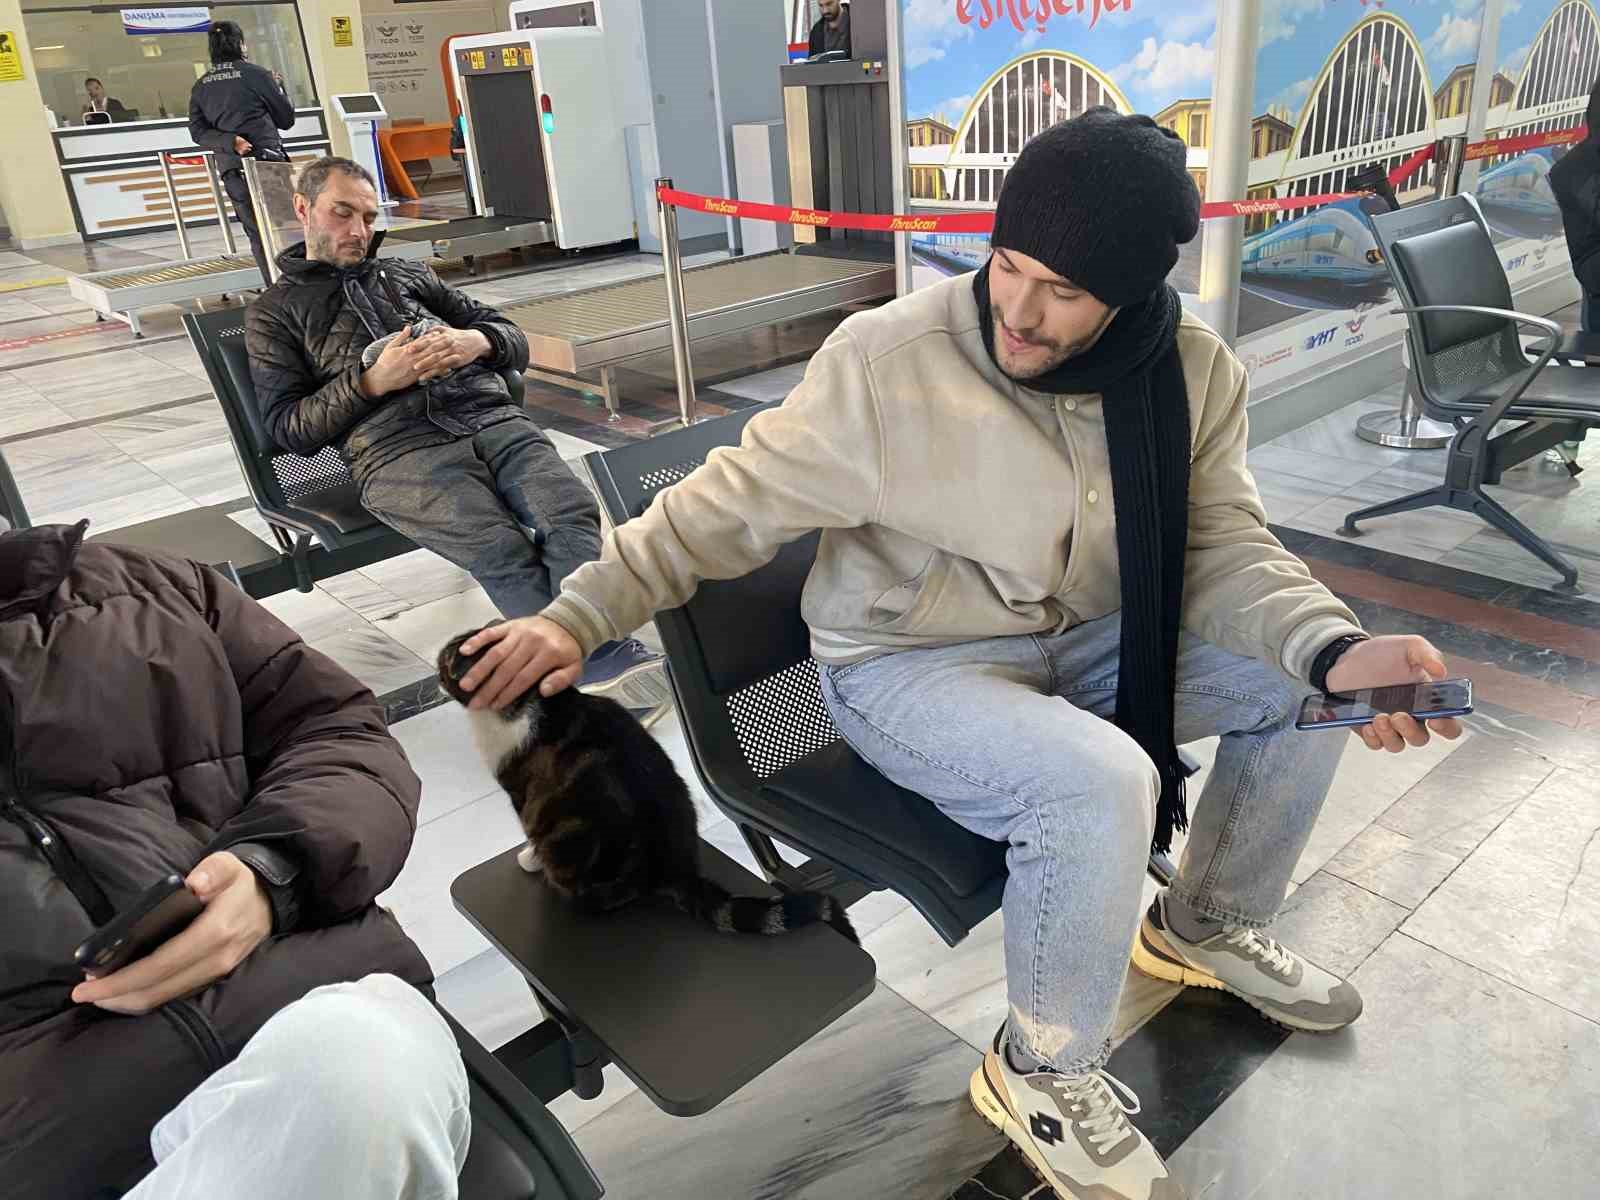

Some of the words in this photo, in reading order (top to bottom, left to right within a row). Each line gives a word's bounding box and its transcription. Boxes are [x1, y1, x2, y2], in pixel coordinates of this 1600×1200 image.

[704, 199, 738, 214] ThruScan
[1232, 201, 1280, 215] ThruScan
[788, 210, 829, 225] ThruScan
[889, 218, 937, 230] ThruScan
[1308, 326, 1339, 350] YHT
